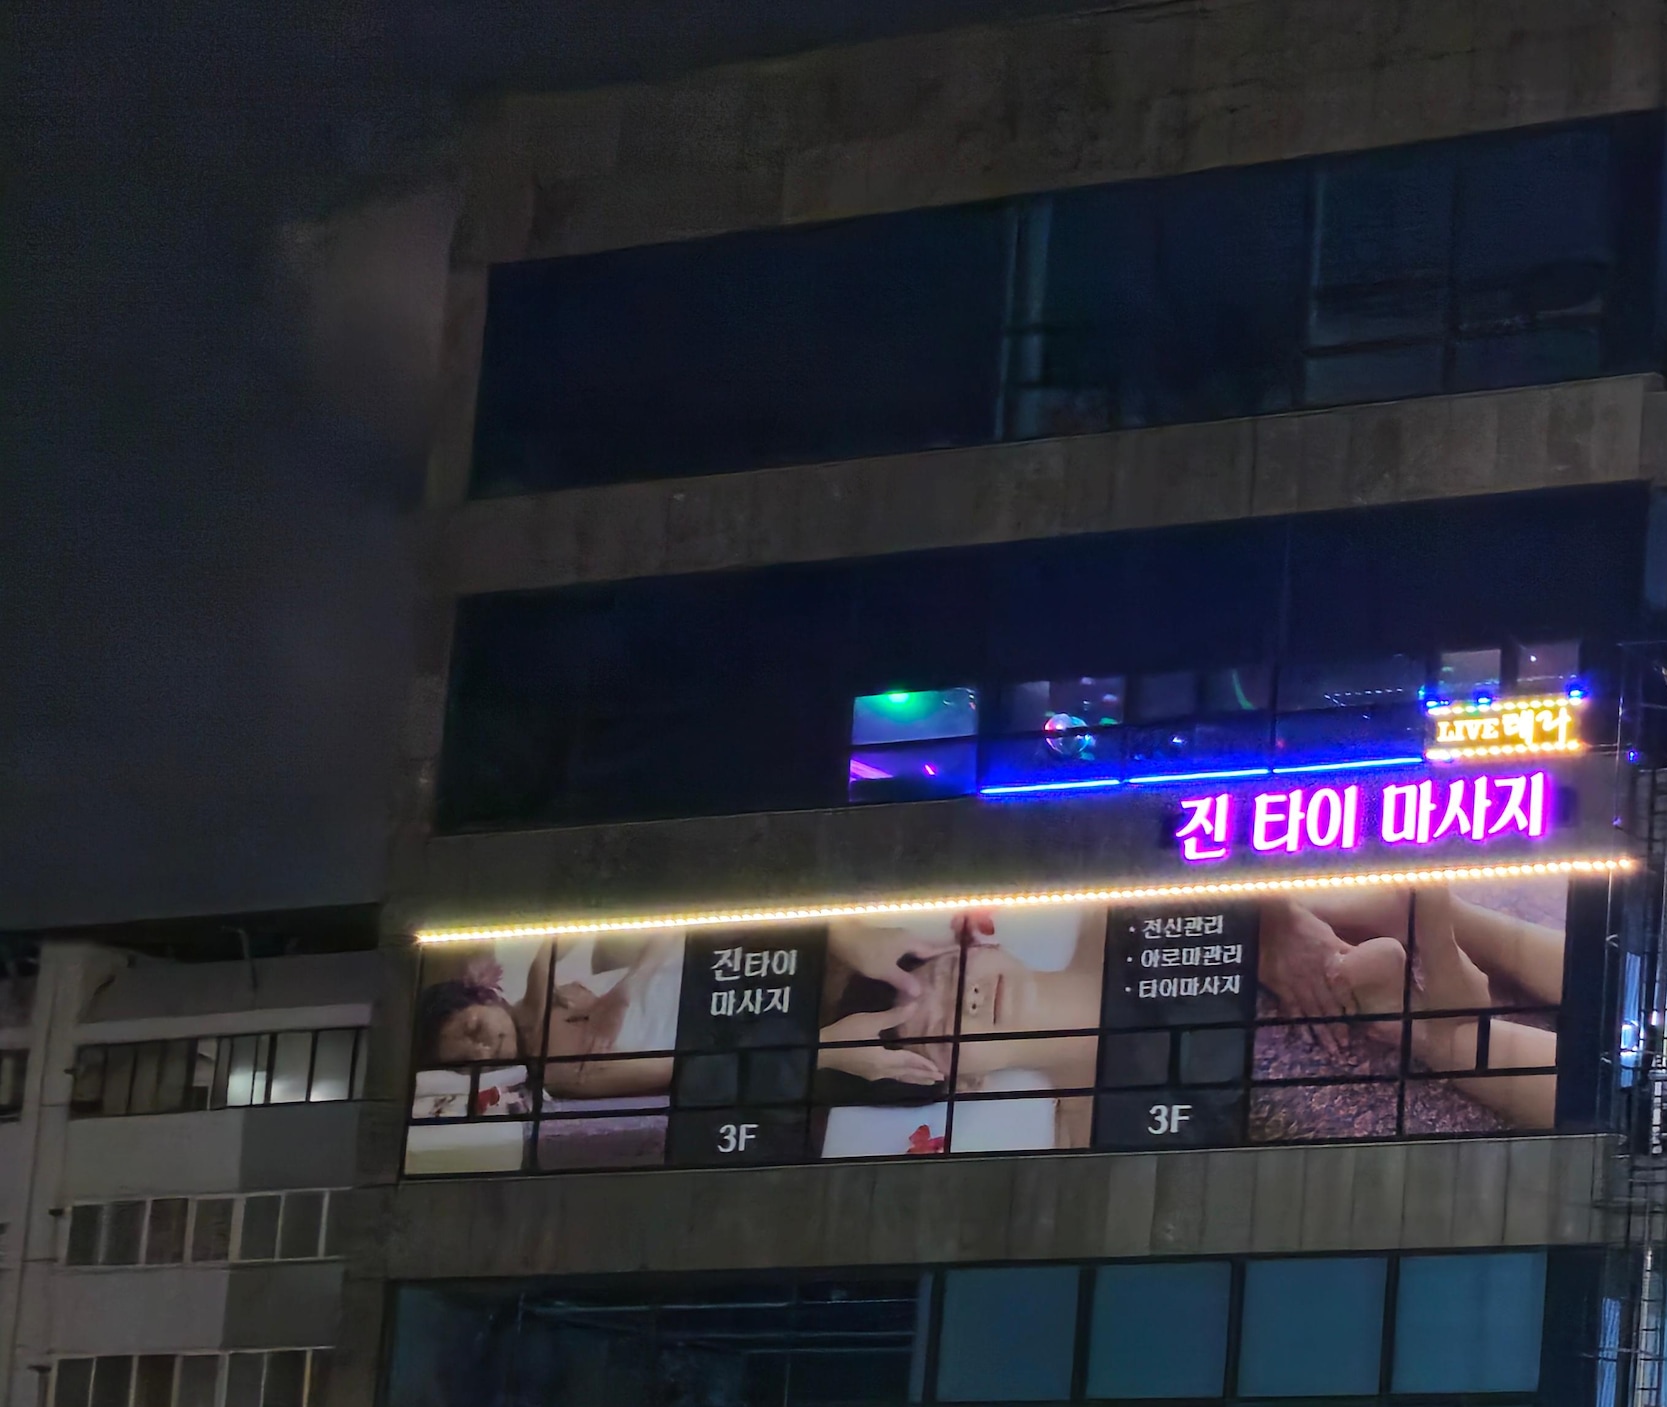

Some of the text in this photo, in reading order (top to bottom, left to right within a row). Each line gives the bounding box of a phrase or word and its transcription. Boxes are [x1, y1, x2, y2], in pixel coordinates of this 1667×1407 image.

[1436, 717, 1500, 743] LIVE
[1175, 771, 1550, 862] 진 타이 마사지
[1141, 915, 1225, 940] 전신관리
[711, 946, 798, 979] 진타이
[1139, 943, 1243, 969] 아로마관리
[1138, 974, 1241, 999] 타이마사지
[710, 988, 790, 1018] 마사지
[1148, 1104, 1192, 1136] 3F
[717, 1123, 759, 1153] 3F
